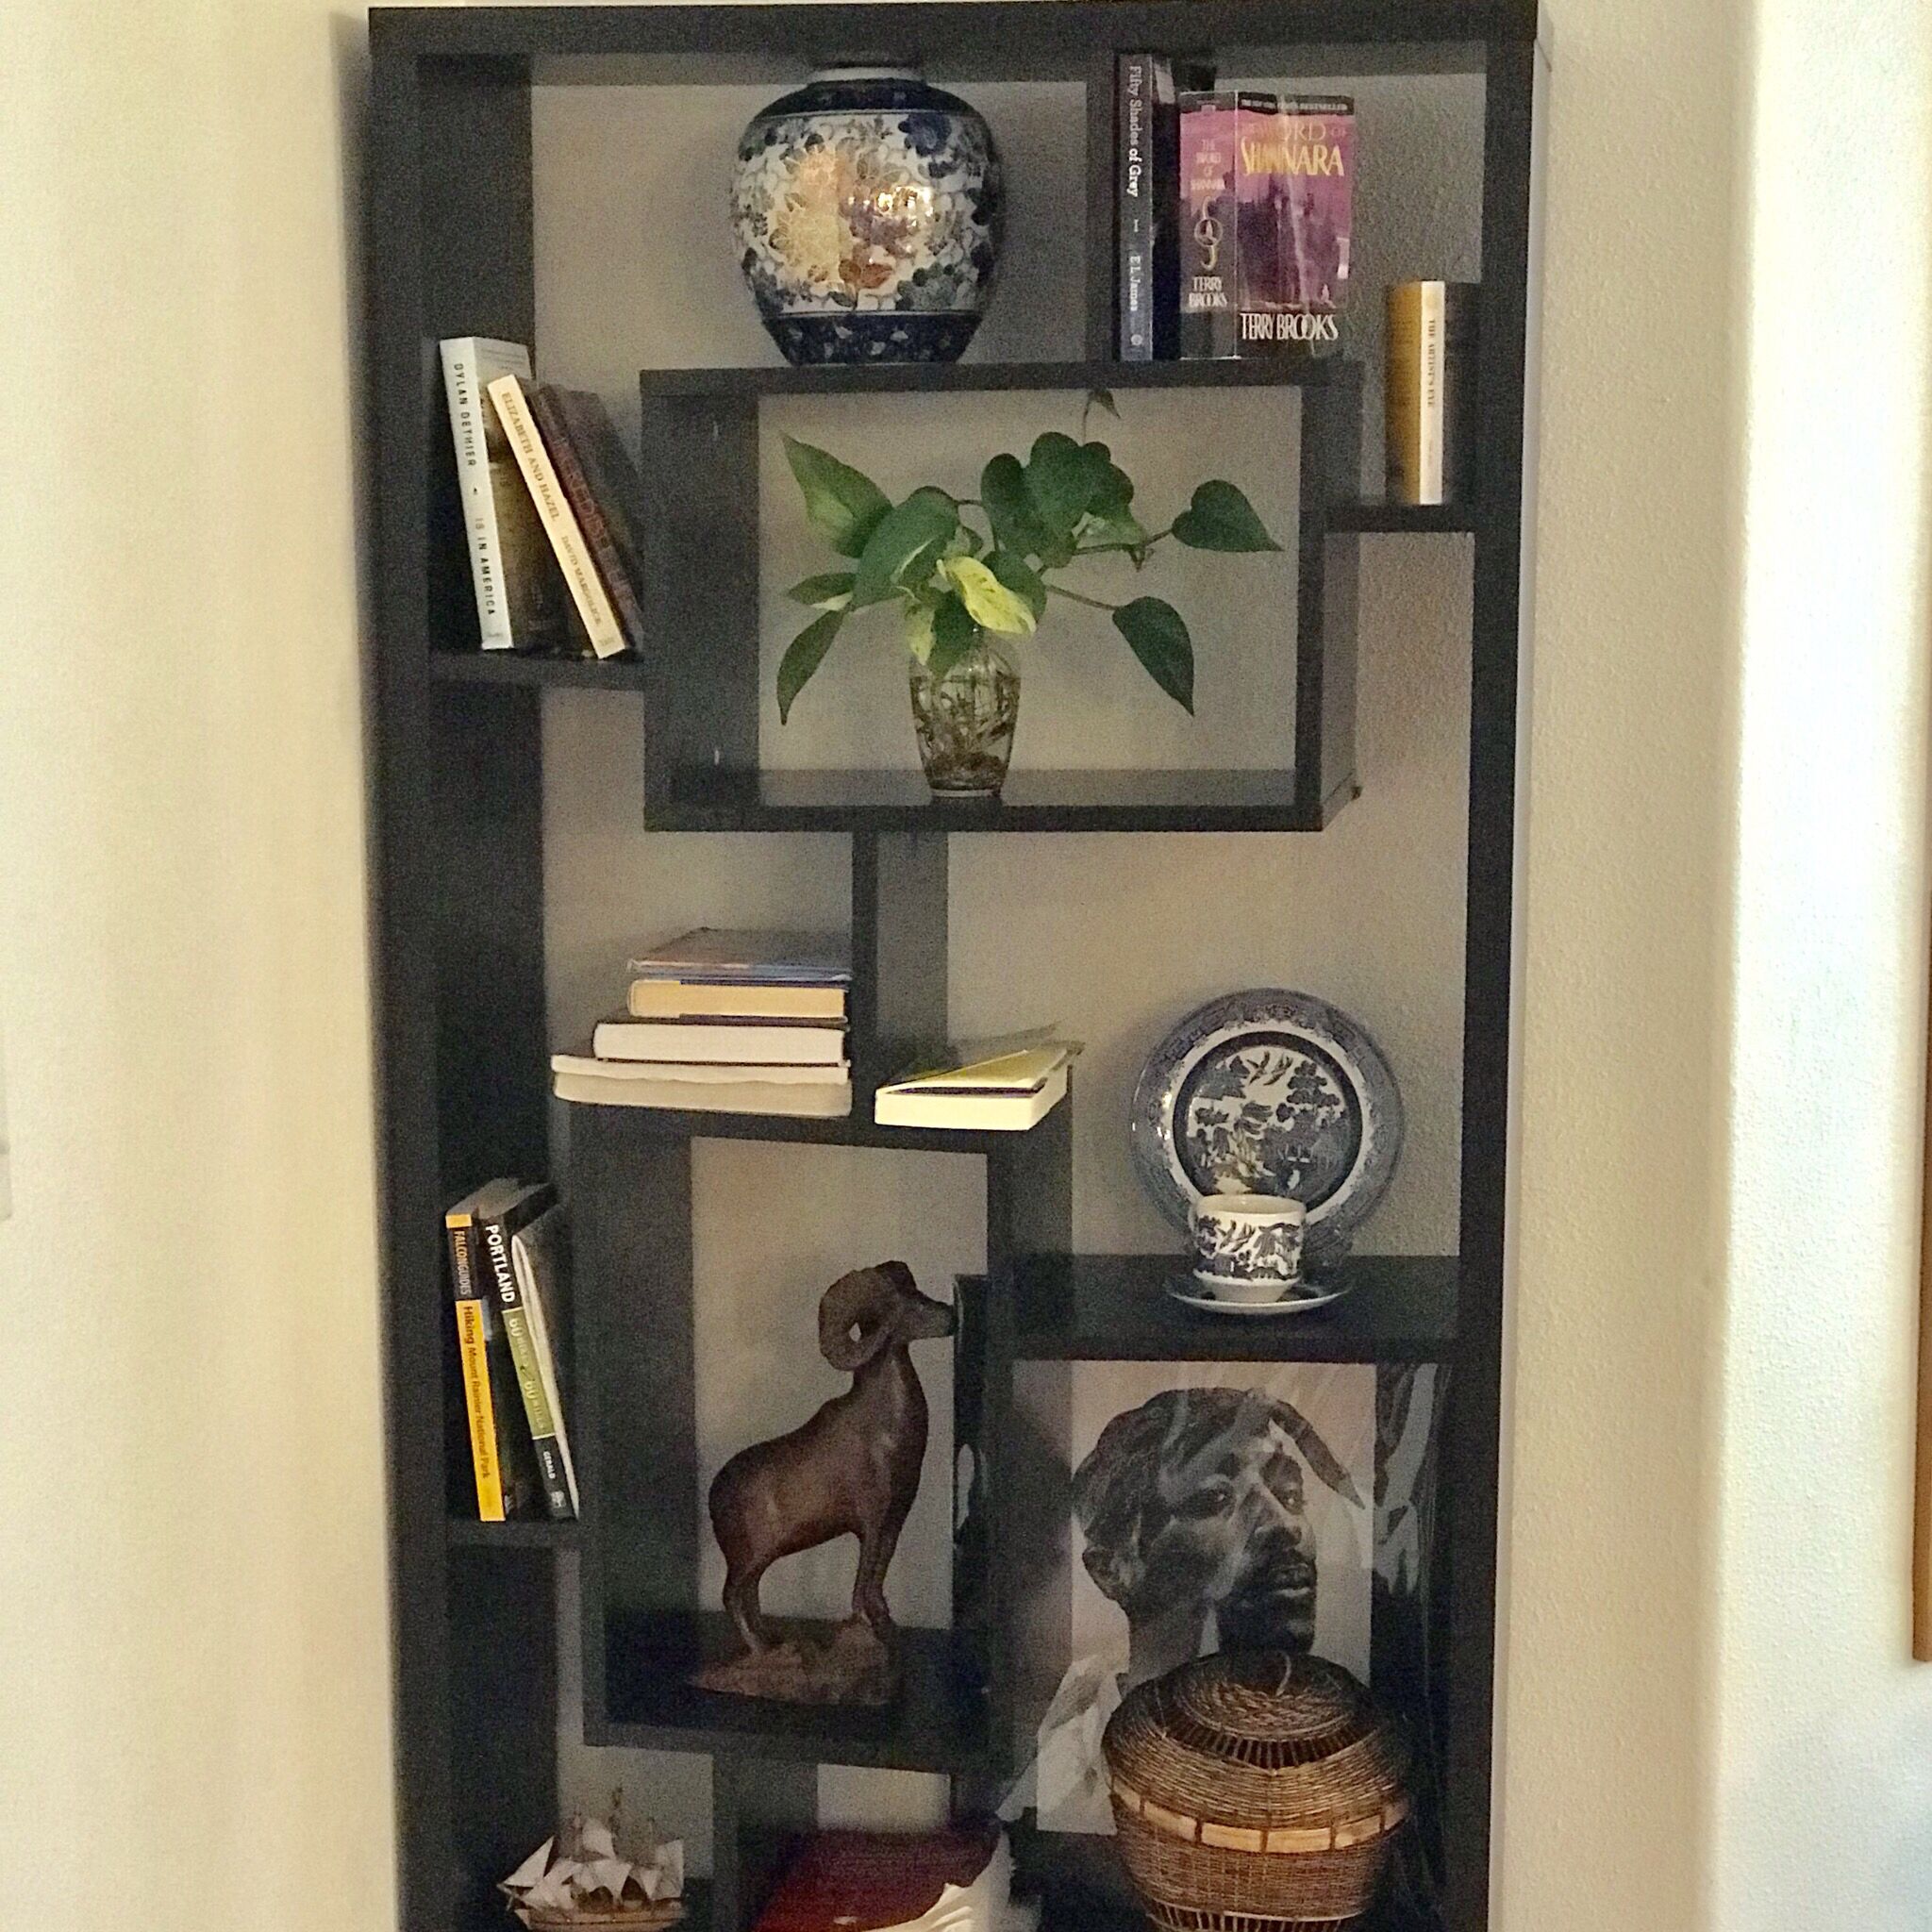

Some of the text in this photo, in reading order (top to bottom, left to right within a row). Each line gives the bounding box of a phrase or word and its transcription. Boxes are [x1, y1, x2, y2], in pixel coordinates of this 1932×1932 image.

[1126, 65, 1143, 197] Fifty Shades of Grey
[1240, 136, 1345, 176] SHNARA
[1130, 277, 1141, 311] James
[1188, 292, 1227, 308] BROOKS
[1192, 276, 1223, 292] TERRY
[1240, 313, 1340, 341] TERRY BROOKS
[454, 362, 476, 467] DYLAN DETHIER
[501, 391, 534, 455] ELIZABETH
[529, 457, 544, 482] AND
[539, 483, 560, 521] HAZEL
[477, 536, 488, 550] IN
[480, 557, 496, 616] AMERICA
[454, 1229, 471, 1296] FALCONGUIDES
[486, 1224, 515, 1304] PORTLAND
[508, 1318, 524, 1337] 60
[463, 1306, 491, 1478] Hiking Mount Rainier National Park
